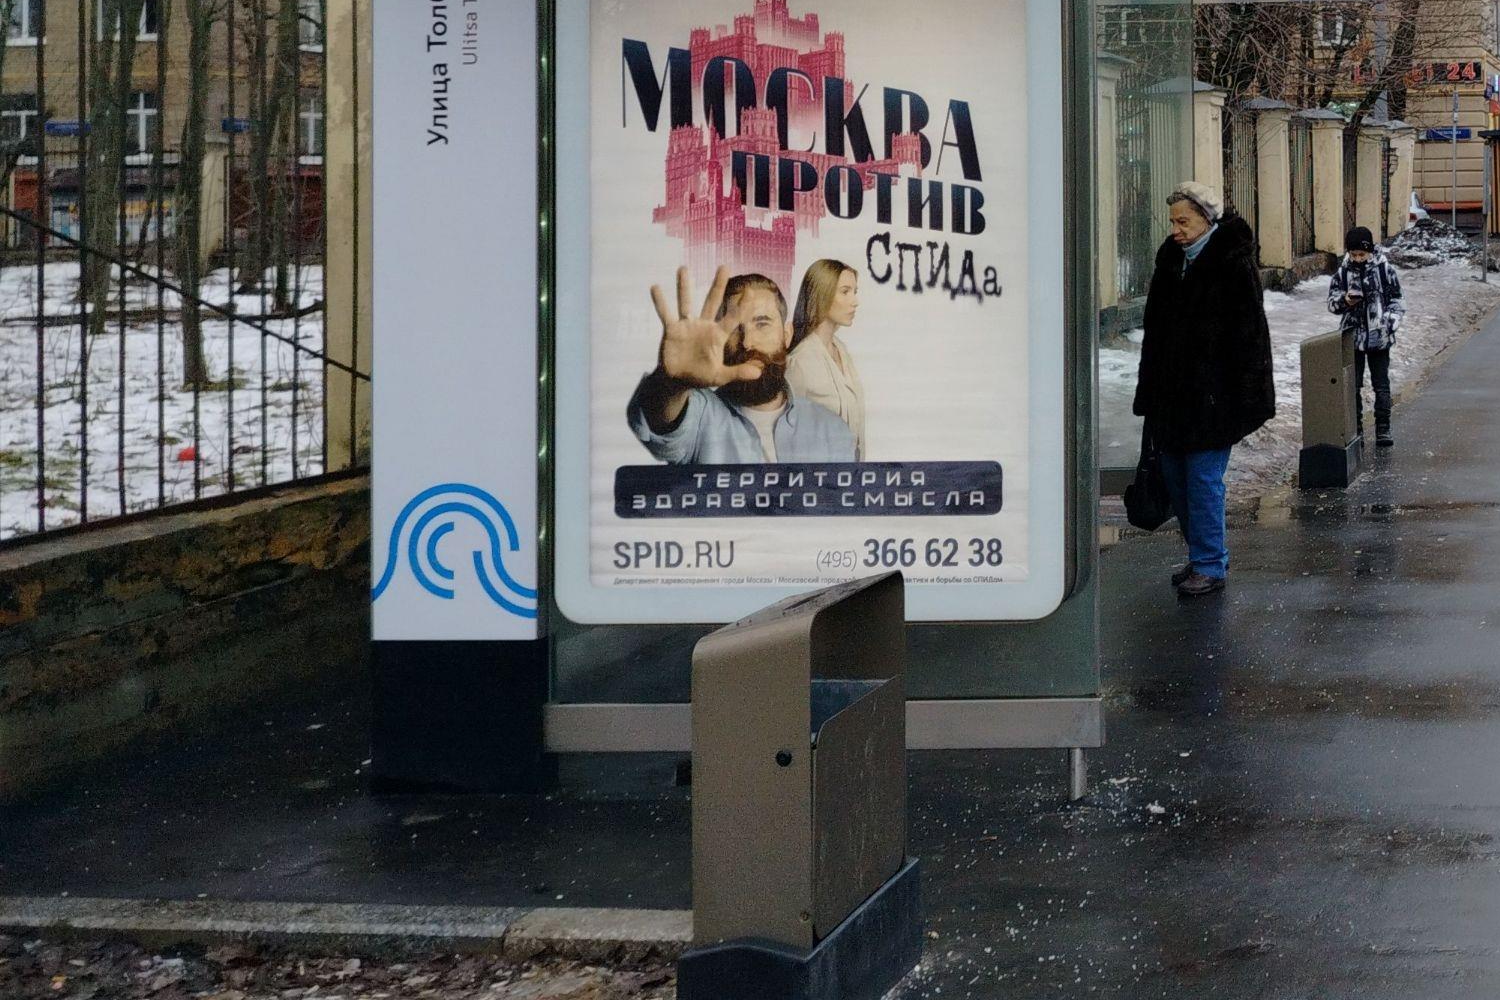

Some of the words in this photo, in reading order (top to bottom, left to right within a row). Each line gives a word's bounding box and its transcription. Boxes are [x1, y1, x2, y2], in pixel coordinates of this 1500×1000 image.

[462, 11, 478, 66] Ulitsa
[1446, 60, 1477, 81] 24
[426, 62, 451, 146] Улица
[621, 37, 983, 182] МОСКВА
[731, 149, 986, 236] ПРОТИВ
[693, 471, 925, 488] ТЕРРИТОРИЯ
[632, 492, 817, 509] ЗДРАВОГО
[841, 490, 985, 507] СМЫСЛА
[613, 540, 734, 569] SPID.RU
[816, 549, 857, 572] (495)
[863, 538, 916, 567] 366
[925, 538, 958, 567] 62
[967, 537, 1003, 567] 38
